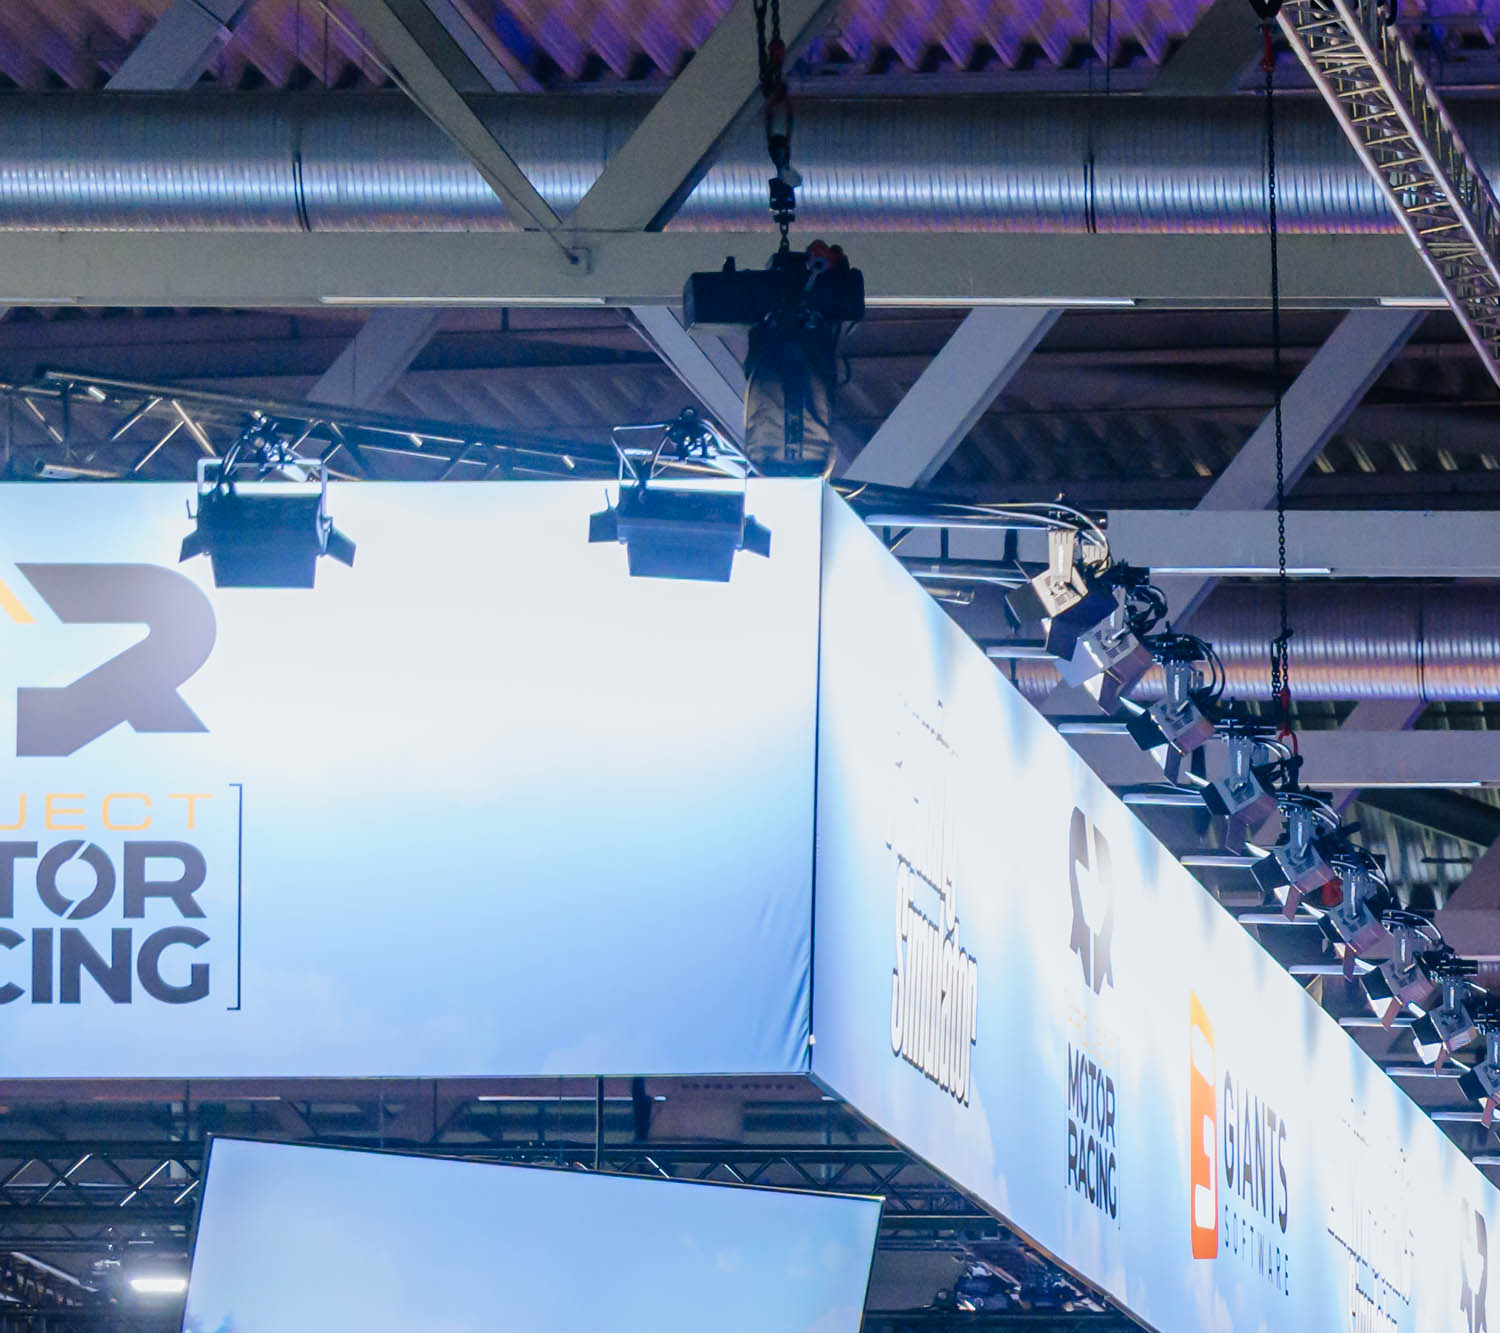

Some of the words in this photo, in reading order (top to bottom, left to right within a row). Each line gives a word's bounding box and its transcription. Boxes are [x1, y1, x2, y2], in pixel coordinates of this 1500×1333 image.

[1067, 1041, 1116, 1149] MOTOR
[1067, 1117, 1117, 1221] RACING
[1224, 1069, 1289, 1235] GIANTS
[1225, 1203, 1289, 1297] SOFTWARE
